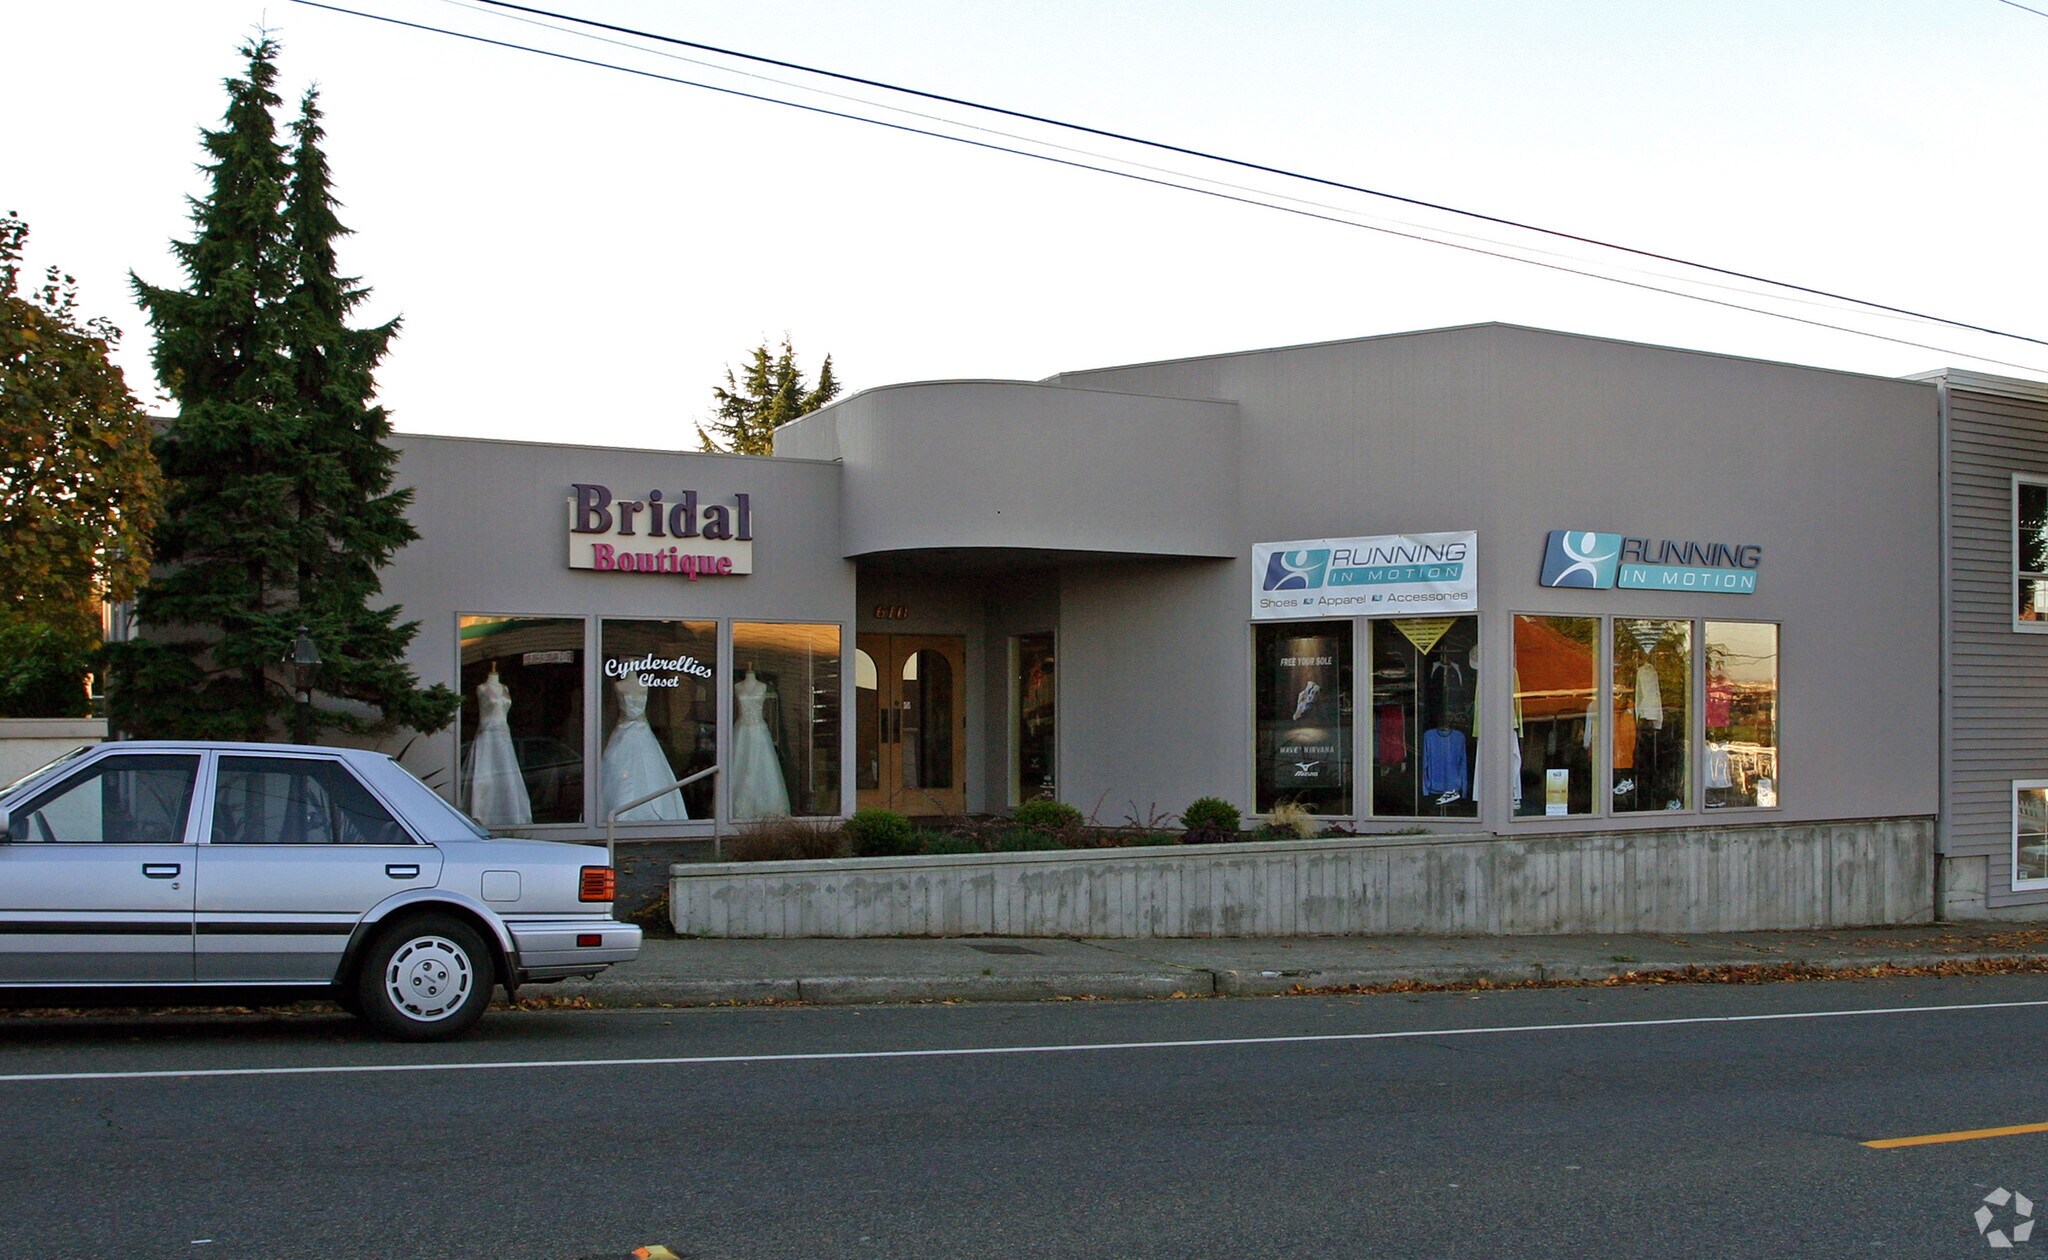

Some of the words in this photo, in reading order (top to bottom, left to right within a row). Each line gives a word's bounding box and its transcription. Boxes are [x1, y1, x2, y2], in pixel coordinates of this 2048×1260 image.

[571, 483, 753, 541] Bridal
[592, 543, 733, 582] Boutique
[1332, 543, 1467, 566] RUNNING
[1620, 537, 1762, 568] RUNNING
[1332, 569, 1353, 582] IN
[1368, 567, 1458, 580] MOTION
[1623, 570, 1646, 583] IN
[1662, 572, 1754, 588] MOTION
[1260, 598, 1298, 608] Shoes
[1318, 595, 1366, 607] Apparel
[1387, 592, 1469, 602] Accessories
[605, 653, 712, 678] Cynderellies
[1280, 657, 1296, 666] FREE
[1297, 657, 1315, 666] YOUR
[639, 673, 680, 687] Closet
